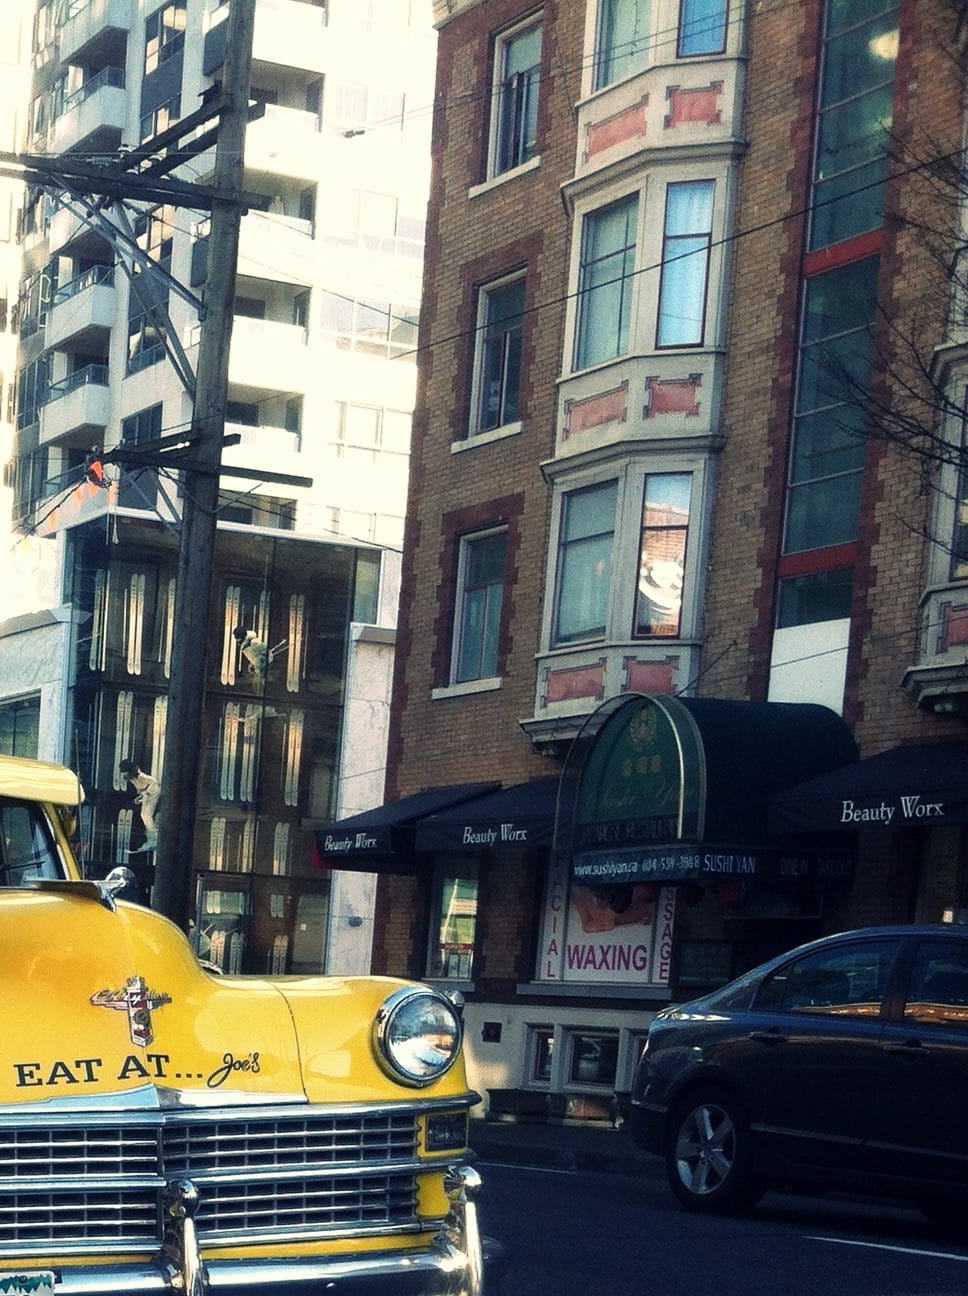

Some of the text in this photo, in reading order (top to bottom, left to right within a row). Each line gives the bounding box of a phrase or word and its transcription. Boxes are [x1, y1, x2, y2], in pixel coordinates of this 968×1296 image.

[840, 795, 944, 825] Beauty Worx
[324, 835, 352, 853] Beauty
[463, 823, 528, 847] Beauty Worx
[702, 854, 756, 873] SUSHI YAN
[568, 944, 648, 970] WAXING
[13, 1058, 102, 1087] EAT
[207, 1052, 261, 1088] Joe's
